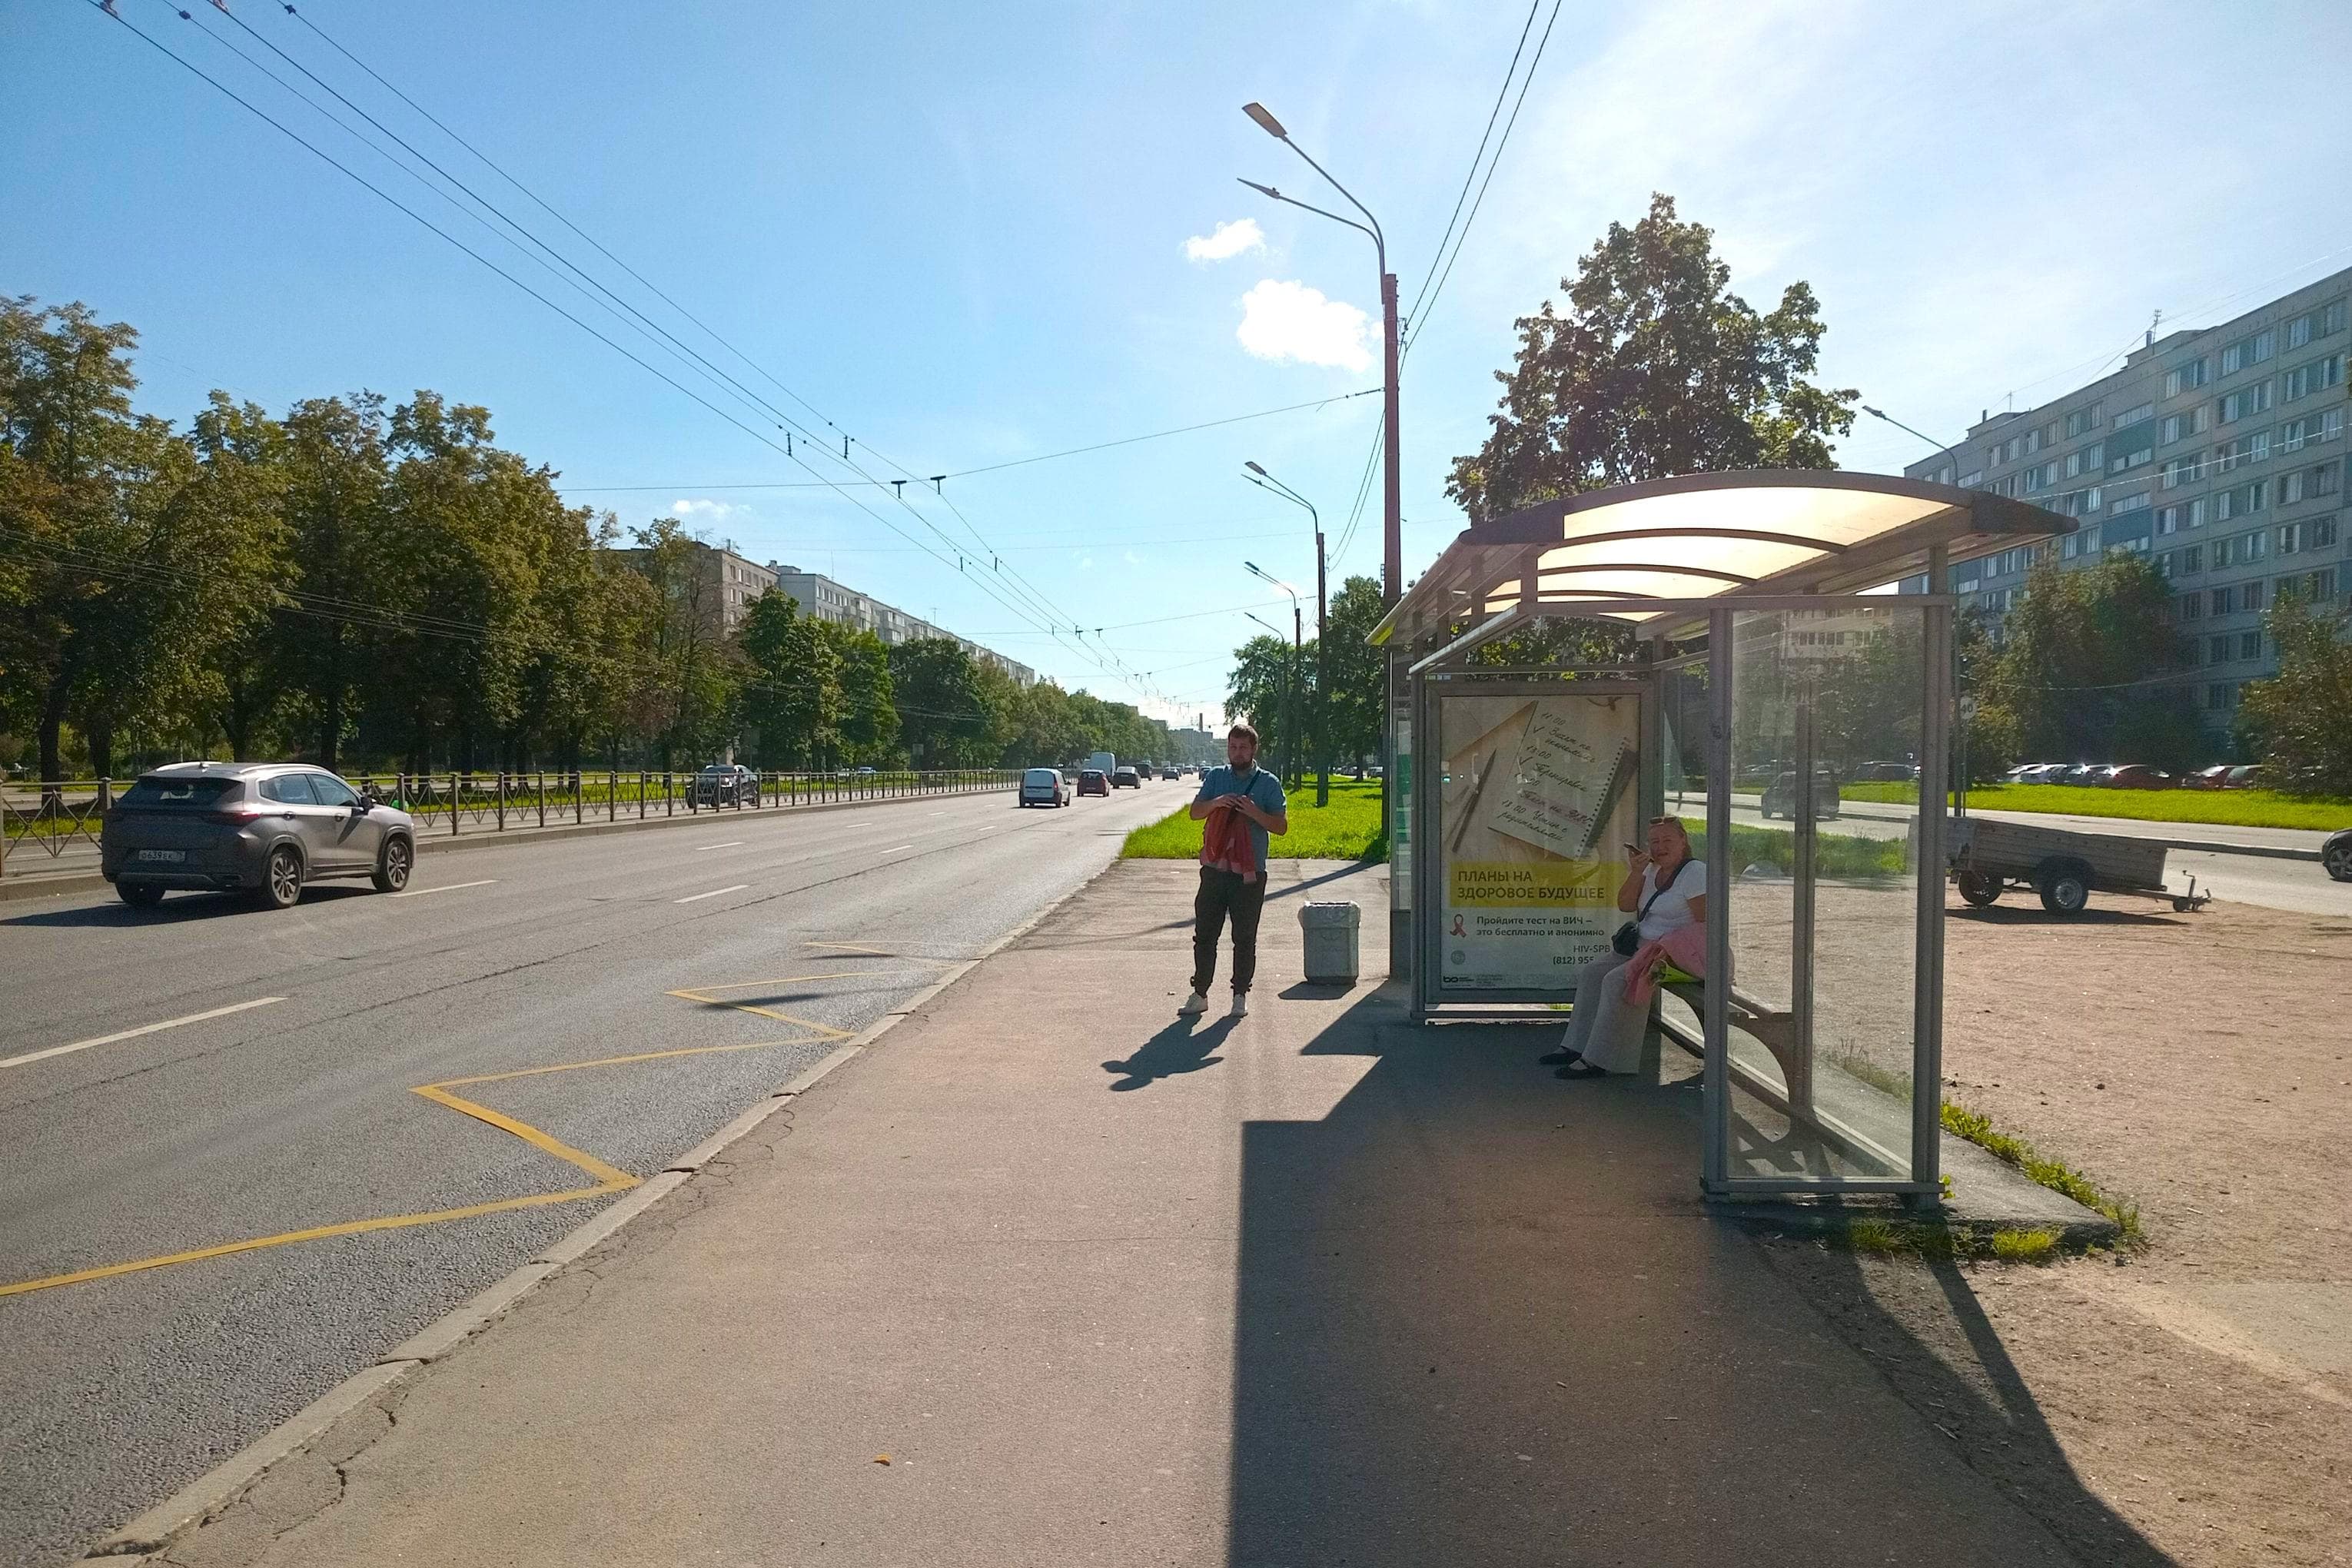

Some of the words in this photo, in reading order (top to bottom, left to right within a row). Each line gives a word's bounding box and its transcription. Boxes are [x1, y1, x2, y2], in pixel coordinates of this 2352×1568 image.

[1961, 703, 1974, 713] 40
[1457, 871, 1509, 882] ПЛАНЫ
[1513, 871, 1533, 882] НА
[1457, 887, 1534, 900] ЗДОРОВОЕ
[1538, 887, 1605, 900] БУДУЩЕЕ
[1477, 915, 1524, 926] Пройдите
[1563, 916, 1583, 925] ВИЧ
[1495, 928, 1546, 937] бесплатно
[1553, 956, 1576, 965] (812)
